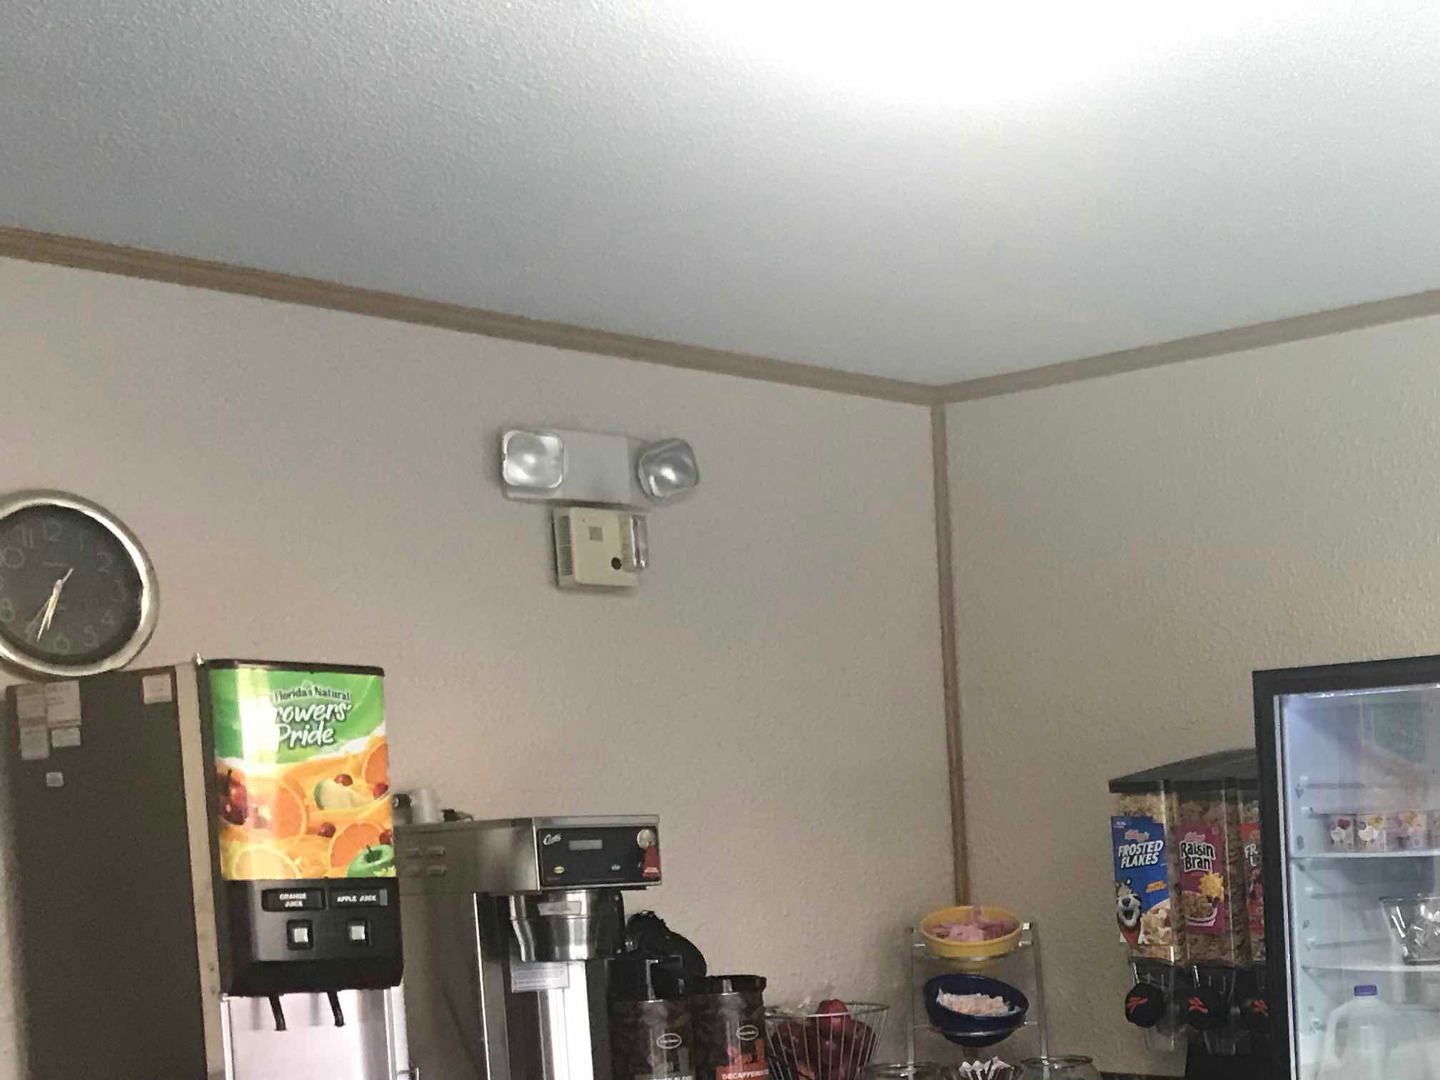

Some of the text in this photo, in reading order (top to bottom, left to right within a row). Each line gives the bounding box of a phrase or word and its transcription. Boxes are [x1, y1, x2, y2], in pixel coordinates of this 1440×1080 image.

[43, 521, 62, 542] 12
[314, 685, 351, 701] Natural
[275, 720, 335, 749] Pride
[1118, 840, 1164, 857] FROSTED
[1179, 840, 1216, 860] Raisin
[1120, 852, 1160, 869] FLAKES
[1184, 855, 1213, 872] Bran
[337, 895, 357, 903] APPLE
